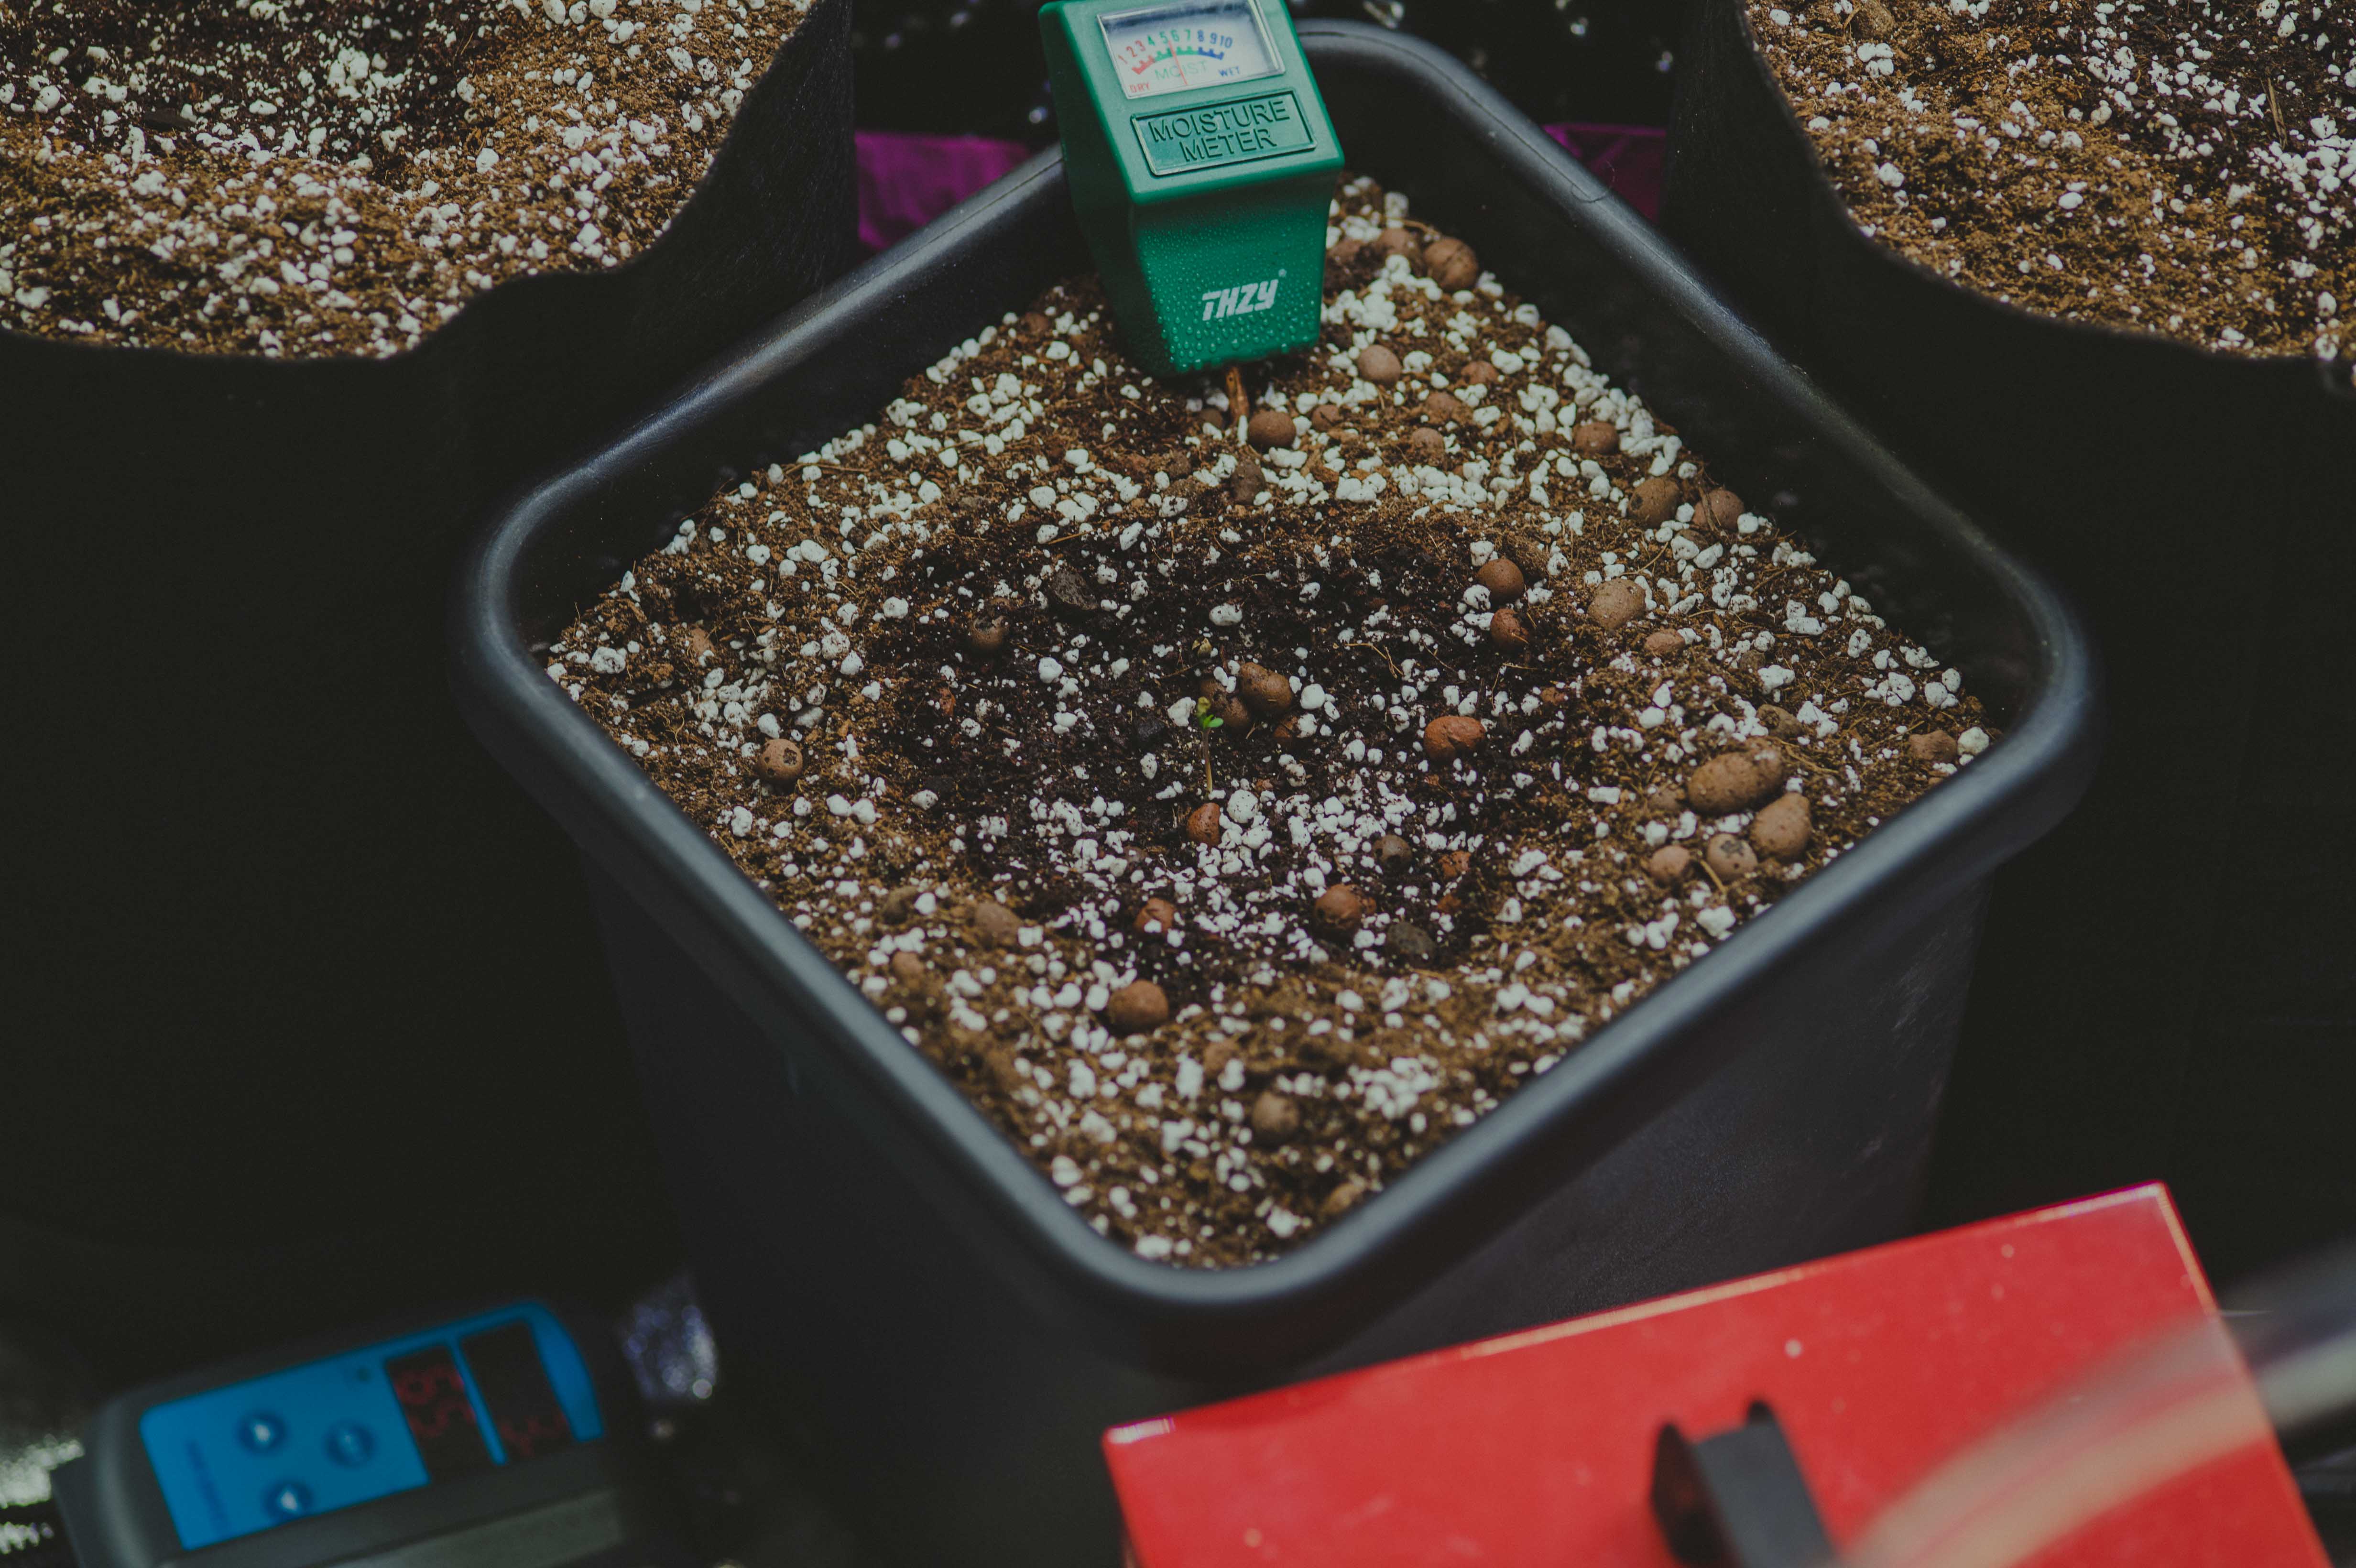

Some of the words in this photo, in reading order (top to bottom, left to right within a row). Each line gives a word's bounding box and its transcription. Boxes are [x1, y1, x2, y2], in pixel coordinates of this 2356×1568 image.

[1118, 54, 1128, 64] 1
[1126, 46, 1137, 57] 2
[1134, 40, 1145, 51] 3
[1147, 35, 1155, 45] 4
[1159, 31, 1168, 44] 5
[1171, 30, 1179, 42] 6
[1184, 29, 1191, 40] 7
[1198, 30, 1204, 42] 8
[1210, 33, 1218, 44] 9
[1220, 35, 1233, 48] 10
[1155, 60, 1207, 80] MOIST
[1219, 66, 1240, 76] WET
[1130, 82, 1150, 93] DRY
[1148, 101, 1290, 142] MOISTURE
[1179, 128, 1277, 162] METER
